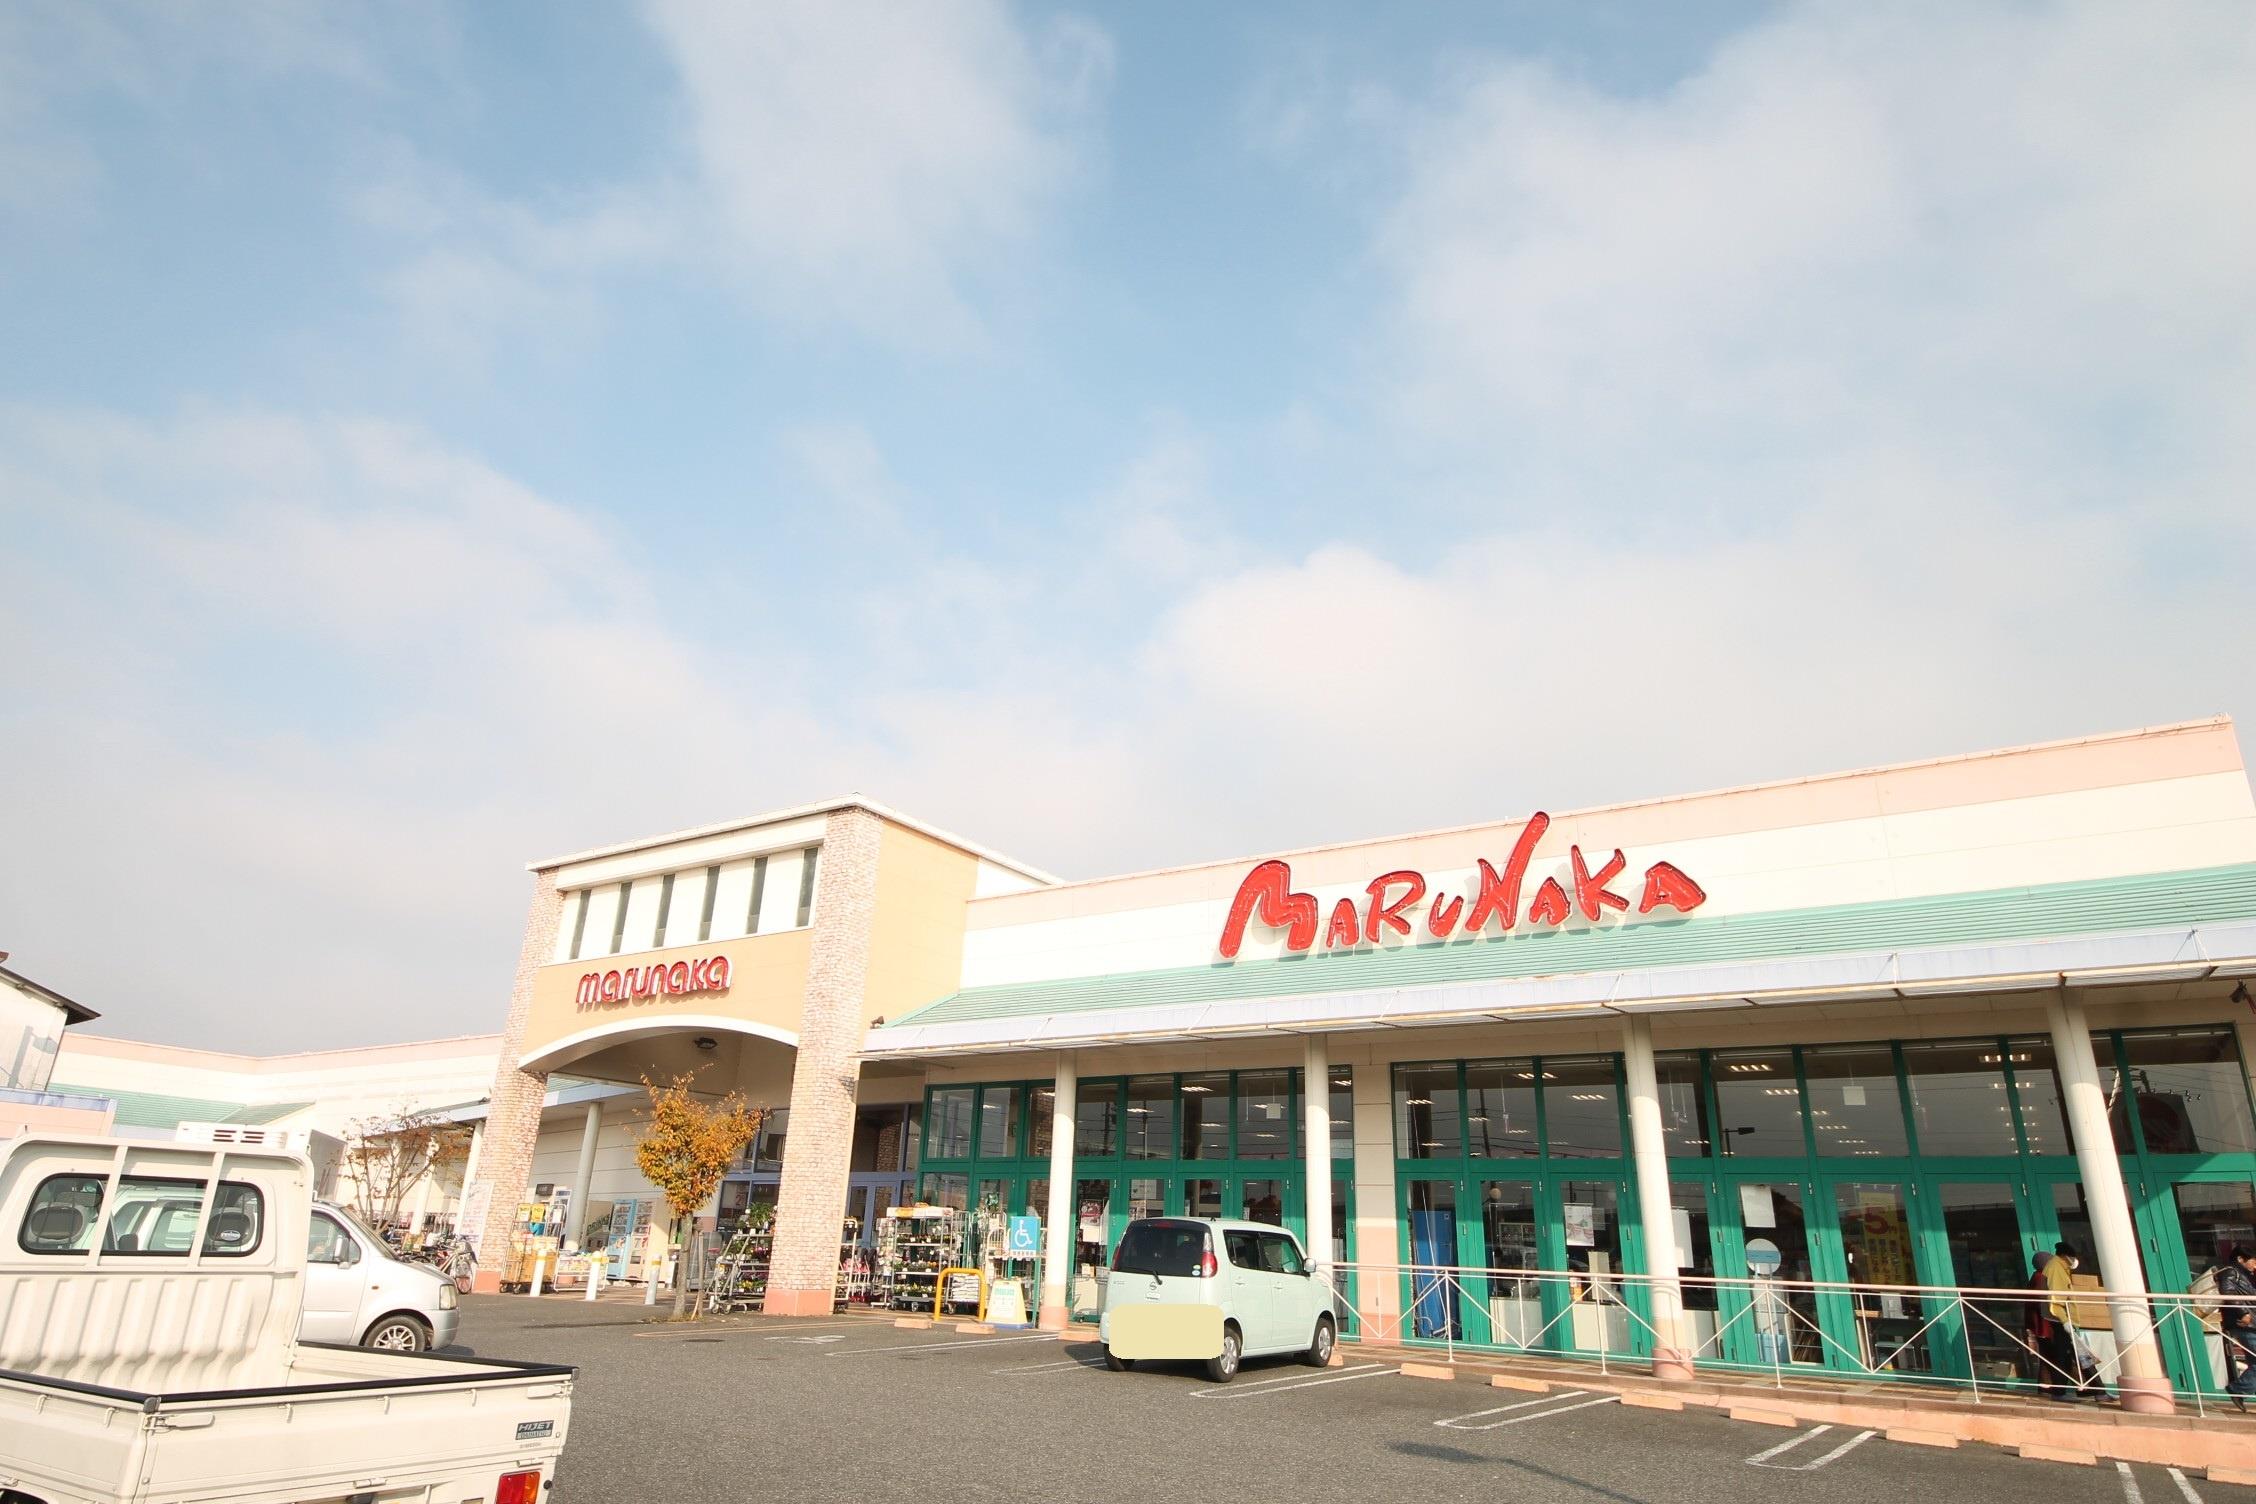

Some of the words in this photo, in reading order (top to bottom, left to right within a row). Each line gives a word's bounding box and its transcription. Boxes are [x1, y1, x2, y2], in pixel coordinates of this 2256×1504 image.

[1220, 811, 1707, 957] MARUNAKA
[576, 956, 731, 1003] marunaka
[518, 1421, 552, 1432] HIJET
